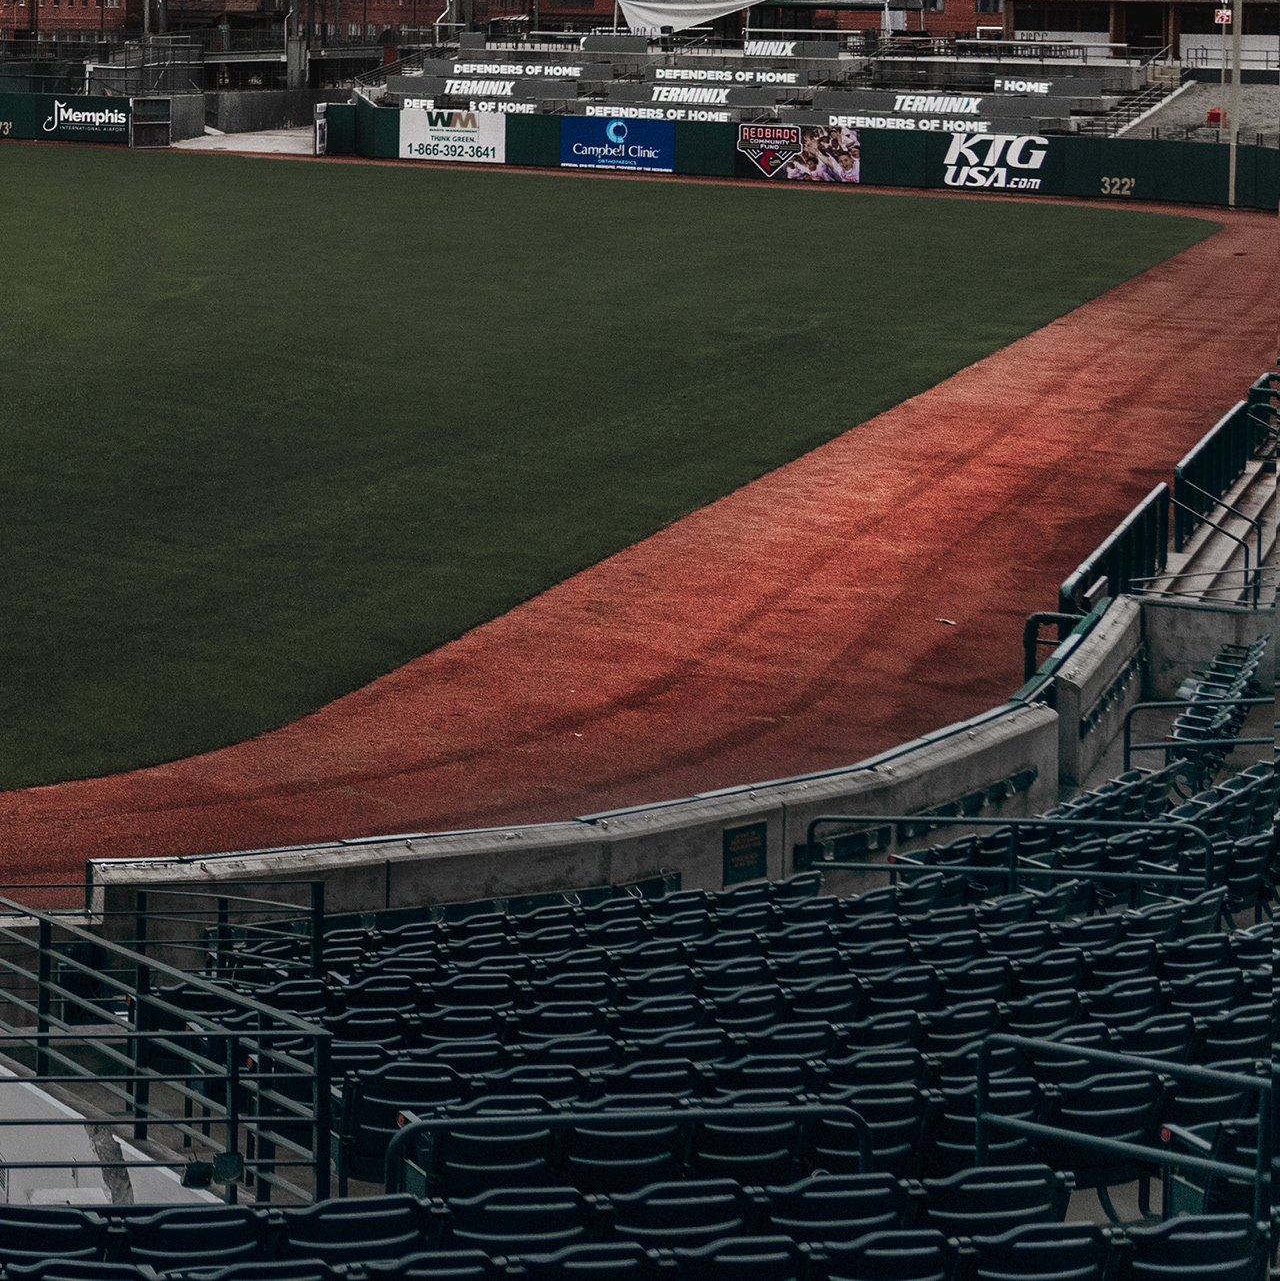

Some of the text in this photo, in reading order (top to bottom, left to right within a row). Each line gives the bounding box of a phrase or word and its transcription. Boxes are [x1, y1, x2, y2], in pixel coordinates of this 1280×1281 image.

[453, 64, 581, 77] DEFENDERS OF HOME
[656, 69, 796, 84] DEFENDERS OF HOME
[444, 79, 515, 95] TERMINIX
[651, 86, 731, 103] TERMINIX
[1004, 80, 1049, 93] HOME
[478, 101, 496, 112] OF
[893, 95, 983, 114] TERMINIX
[60, 107, 127, 126] Memphis
[426, 111, 478, 129] WM
[586, 106, 728, 122] DEFENDERS OF HOME
[829, 116, 988, 132] DEFENDERS OF HOME
[742, 127, 797, 143] REDBIRDS
[407, 142, 496, 159] 1-866-392-3641
[572, 142, 660, 159] Campbell Clinic
[943, 133, 1049, 169] KTG
